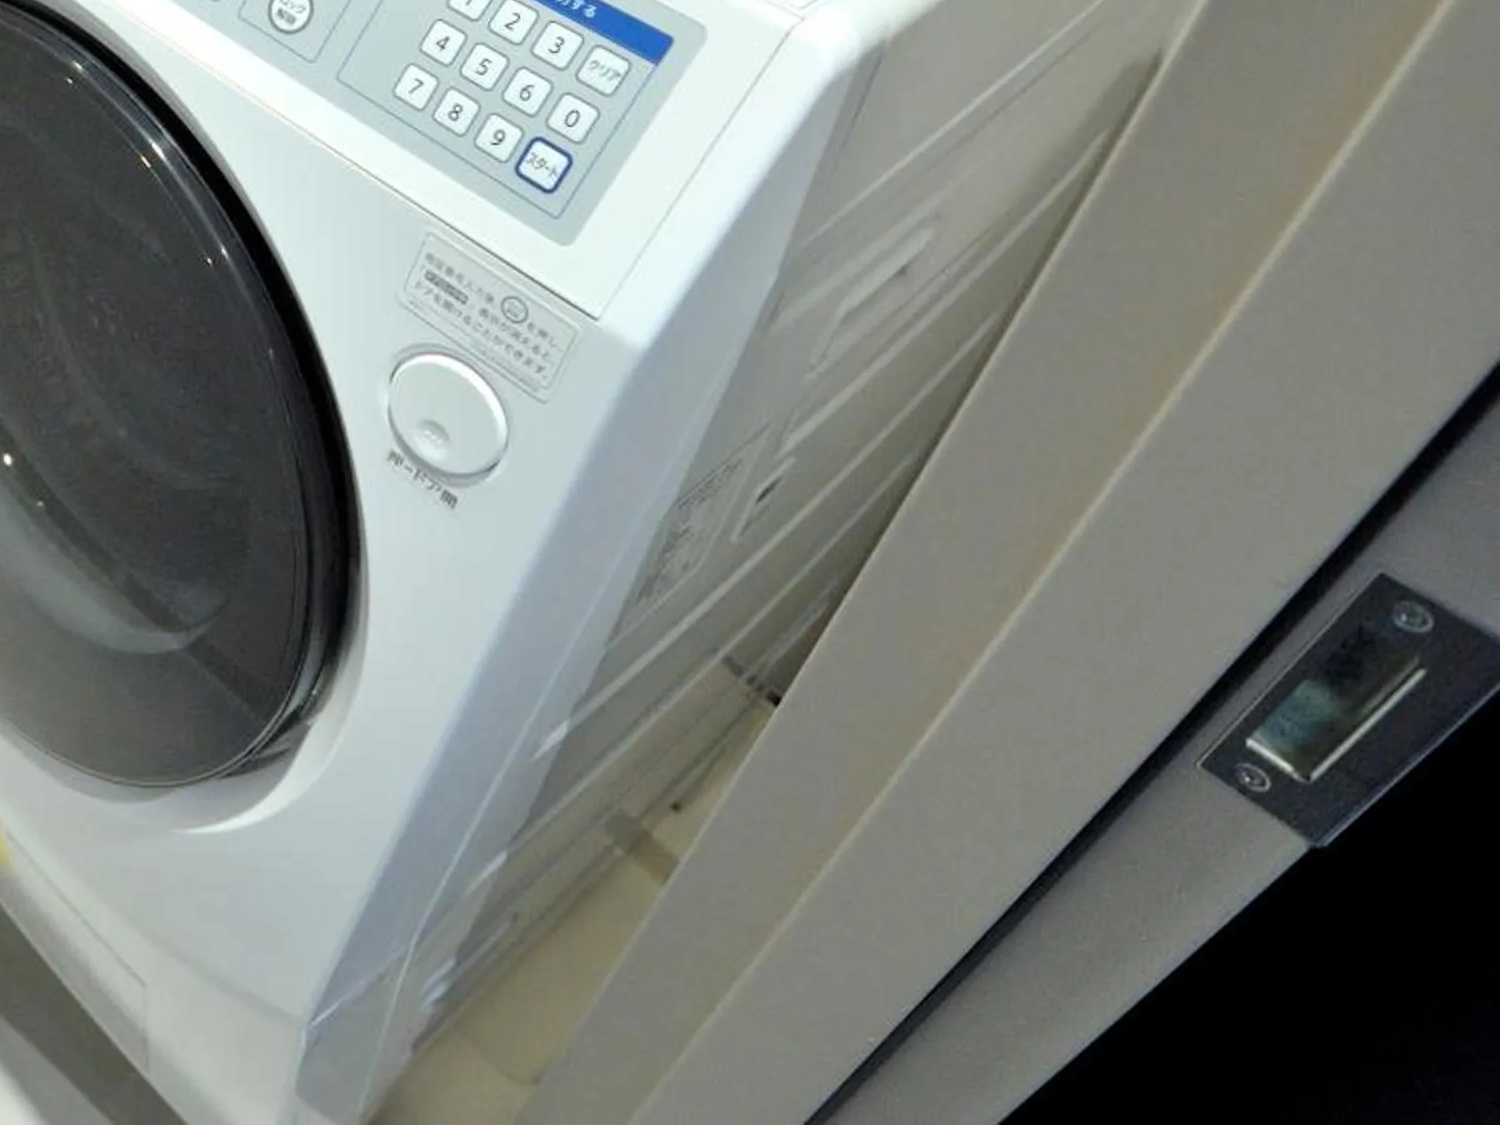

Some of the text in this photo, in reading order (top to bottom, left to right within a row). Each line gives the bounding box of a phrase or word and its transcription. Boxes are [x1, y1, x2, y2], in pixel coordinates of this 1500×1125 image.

[504, 11, 523, 32] 2
[548, 36, 566, 56] 3
[408, 78, 424, 95] 7
[447, 103, 464, 122] 8
[490, 128, 507, 147] 9
[435, 35, 581, 128] 4 5 6 0
